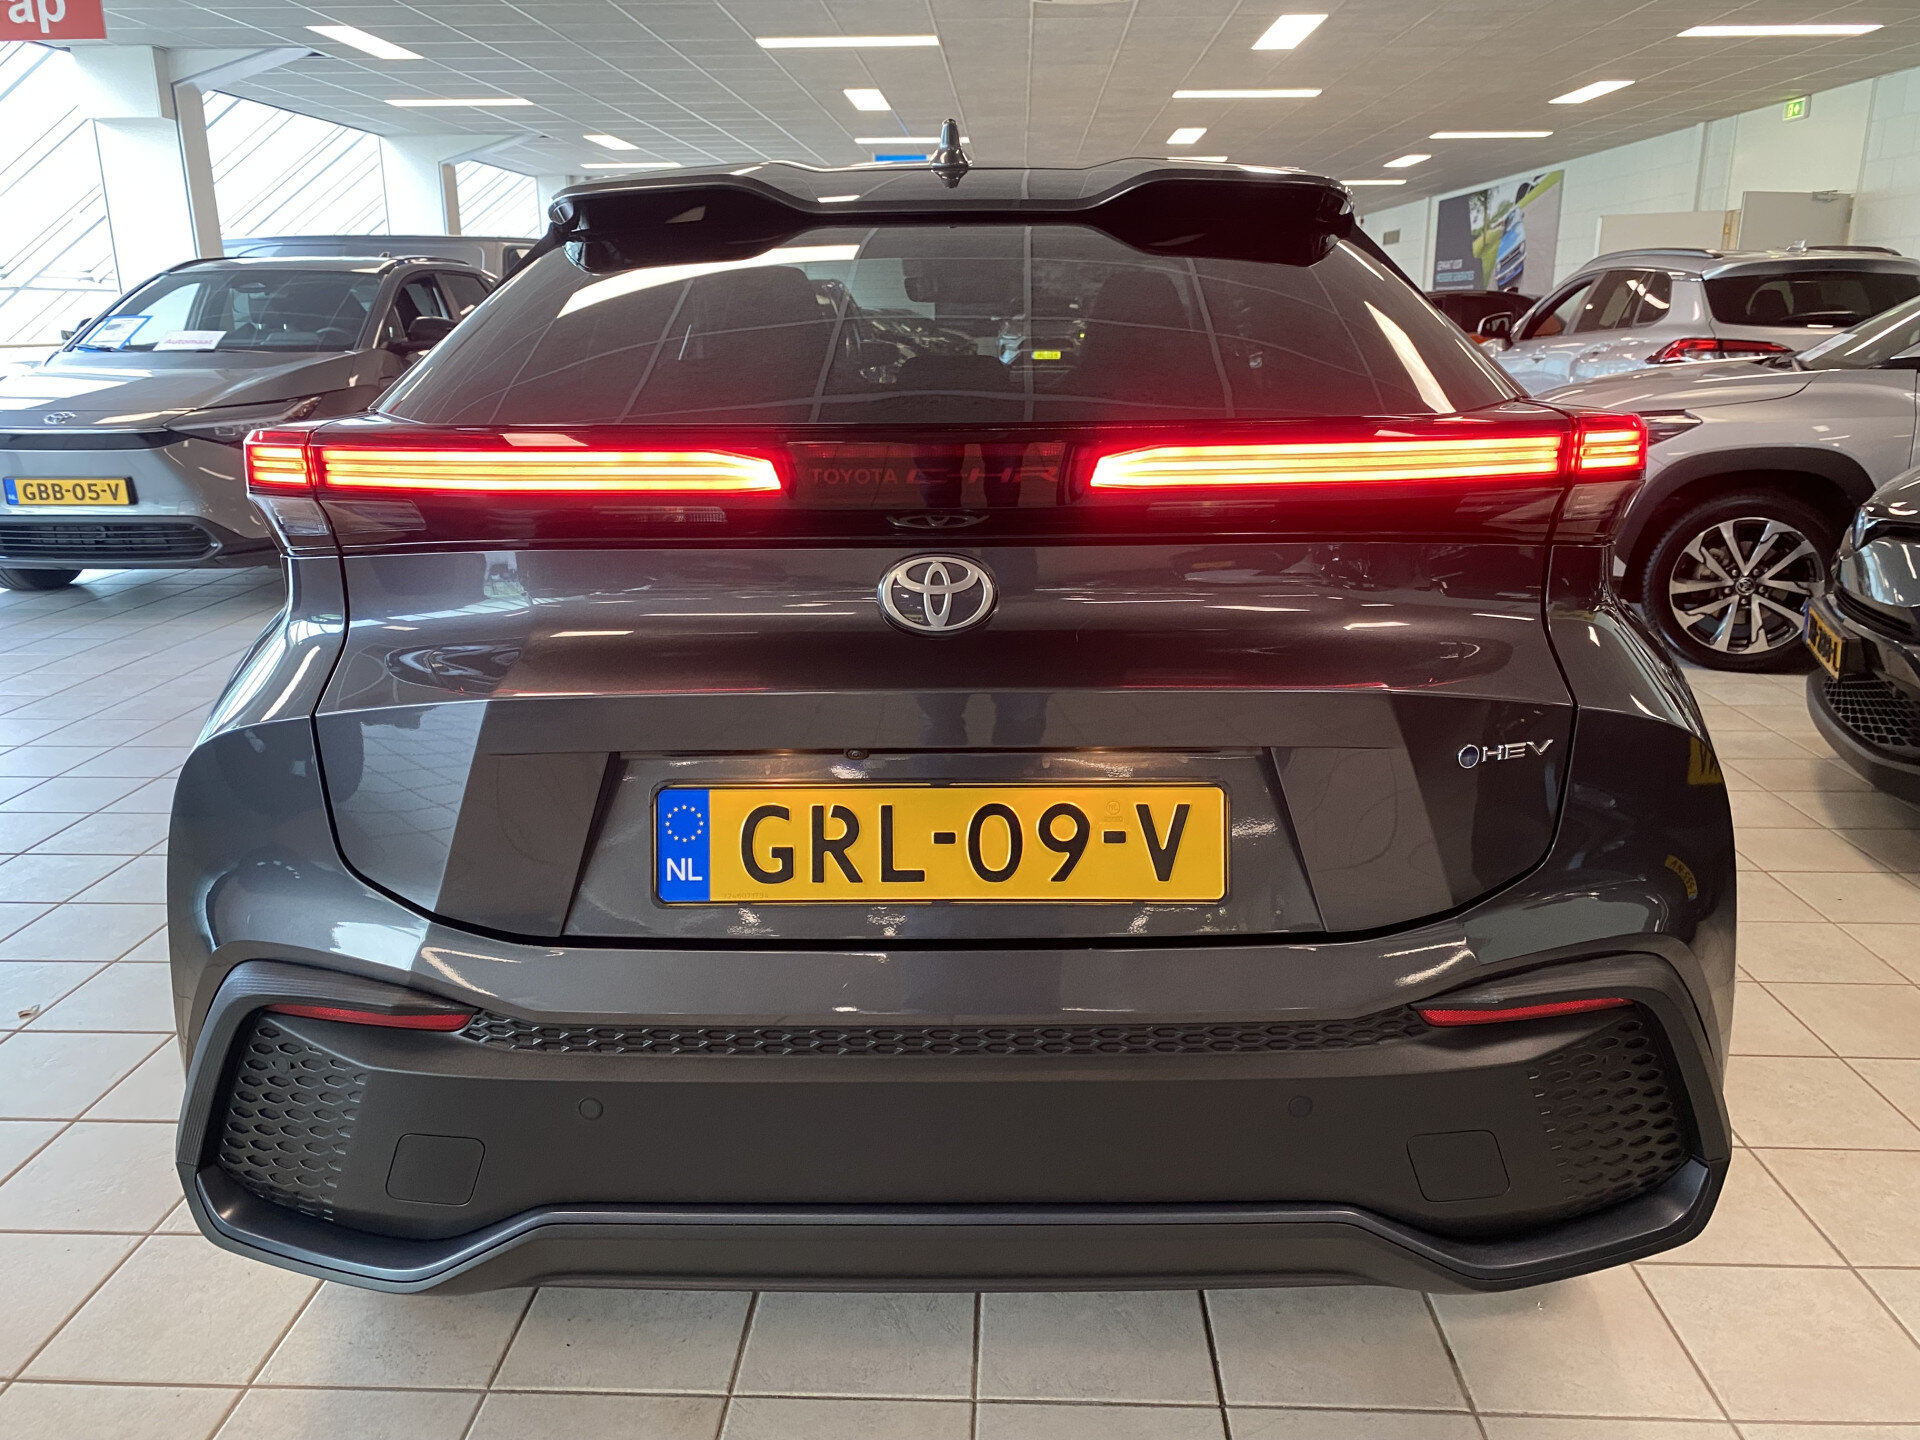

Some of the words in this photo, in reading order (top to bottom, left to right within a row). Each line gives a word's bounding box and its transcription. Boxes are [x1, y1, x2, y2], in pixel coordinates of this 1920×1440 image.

[812, 467, 899, 485] TOYOTA
[22, 482, 119, 501] GBB-05-V
[1481, 739, 1554, 762] HEV
[666, 857, 703, 881] NL
[740, 803, 1190, 884] GRL-09-V
